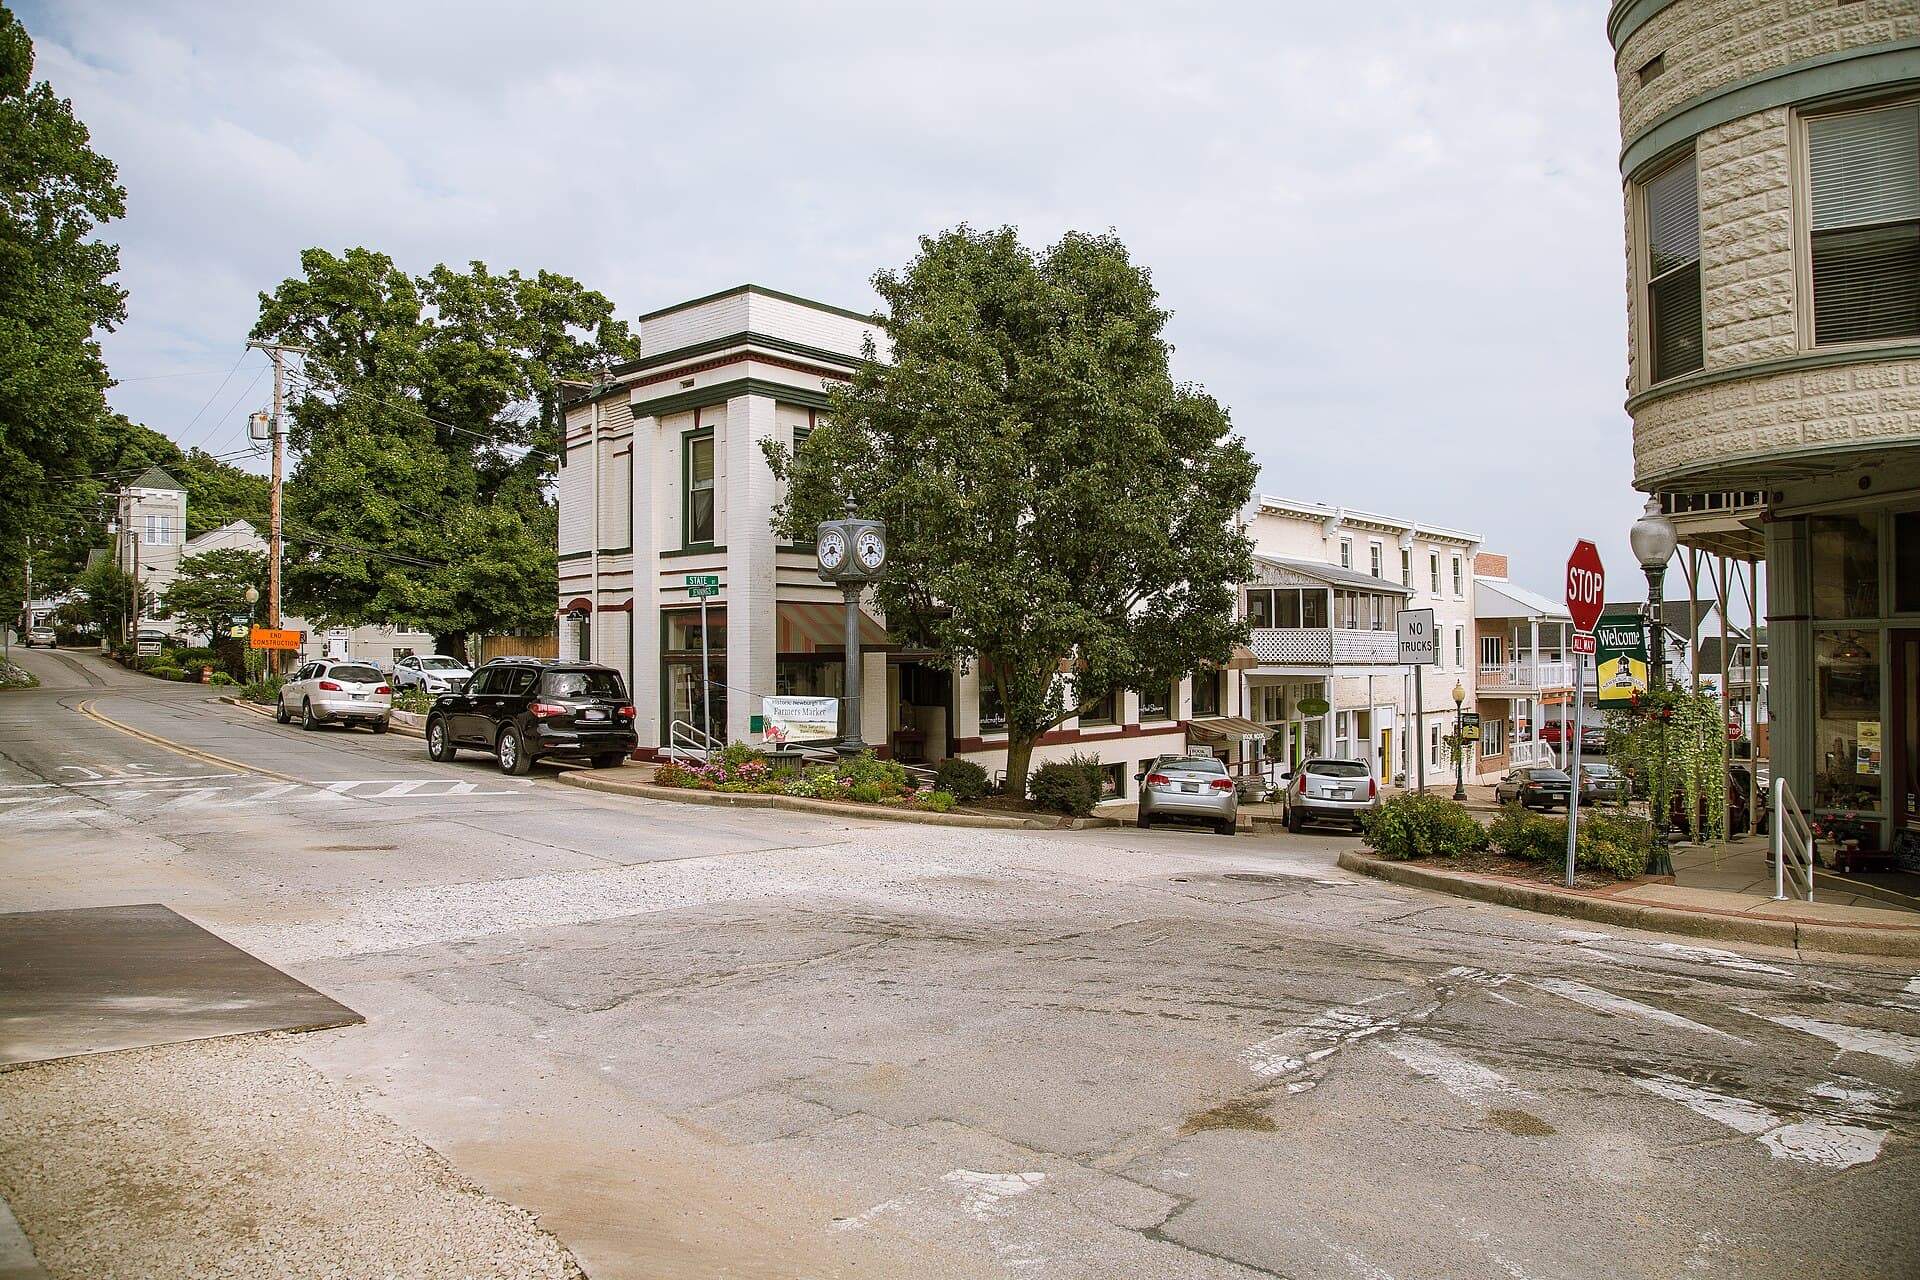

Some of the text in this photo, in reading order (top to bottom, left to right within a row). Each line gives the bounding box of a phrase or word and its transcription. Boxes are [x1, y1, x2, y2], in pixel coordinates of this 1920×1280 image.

[689, 576, 708, 585] STATE
[1568, 566, 1603, 605] STOP
[1409, 622, 1423, 636] NO
[1598, 627, 1641, 647] Welcome
[1401, 640, 1433, 652] TRUCKS
[1574, 638, 1594, 651] ALL WAY
[773, 707, 827, 716] Farmers Market
[1729, 727, 1741, 735] TOP
